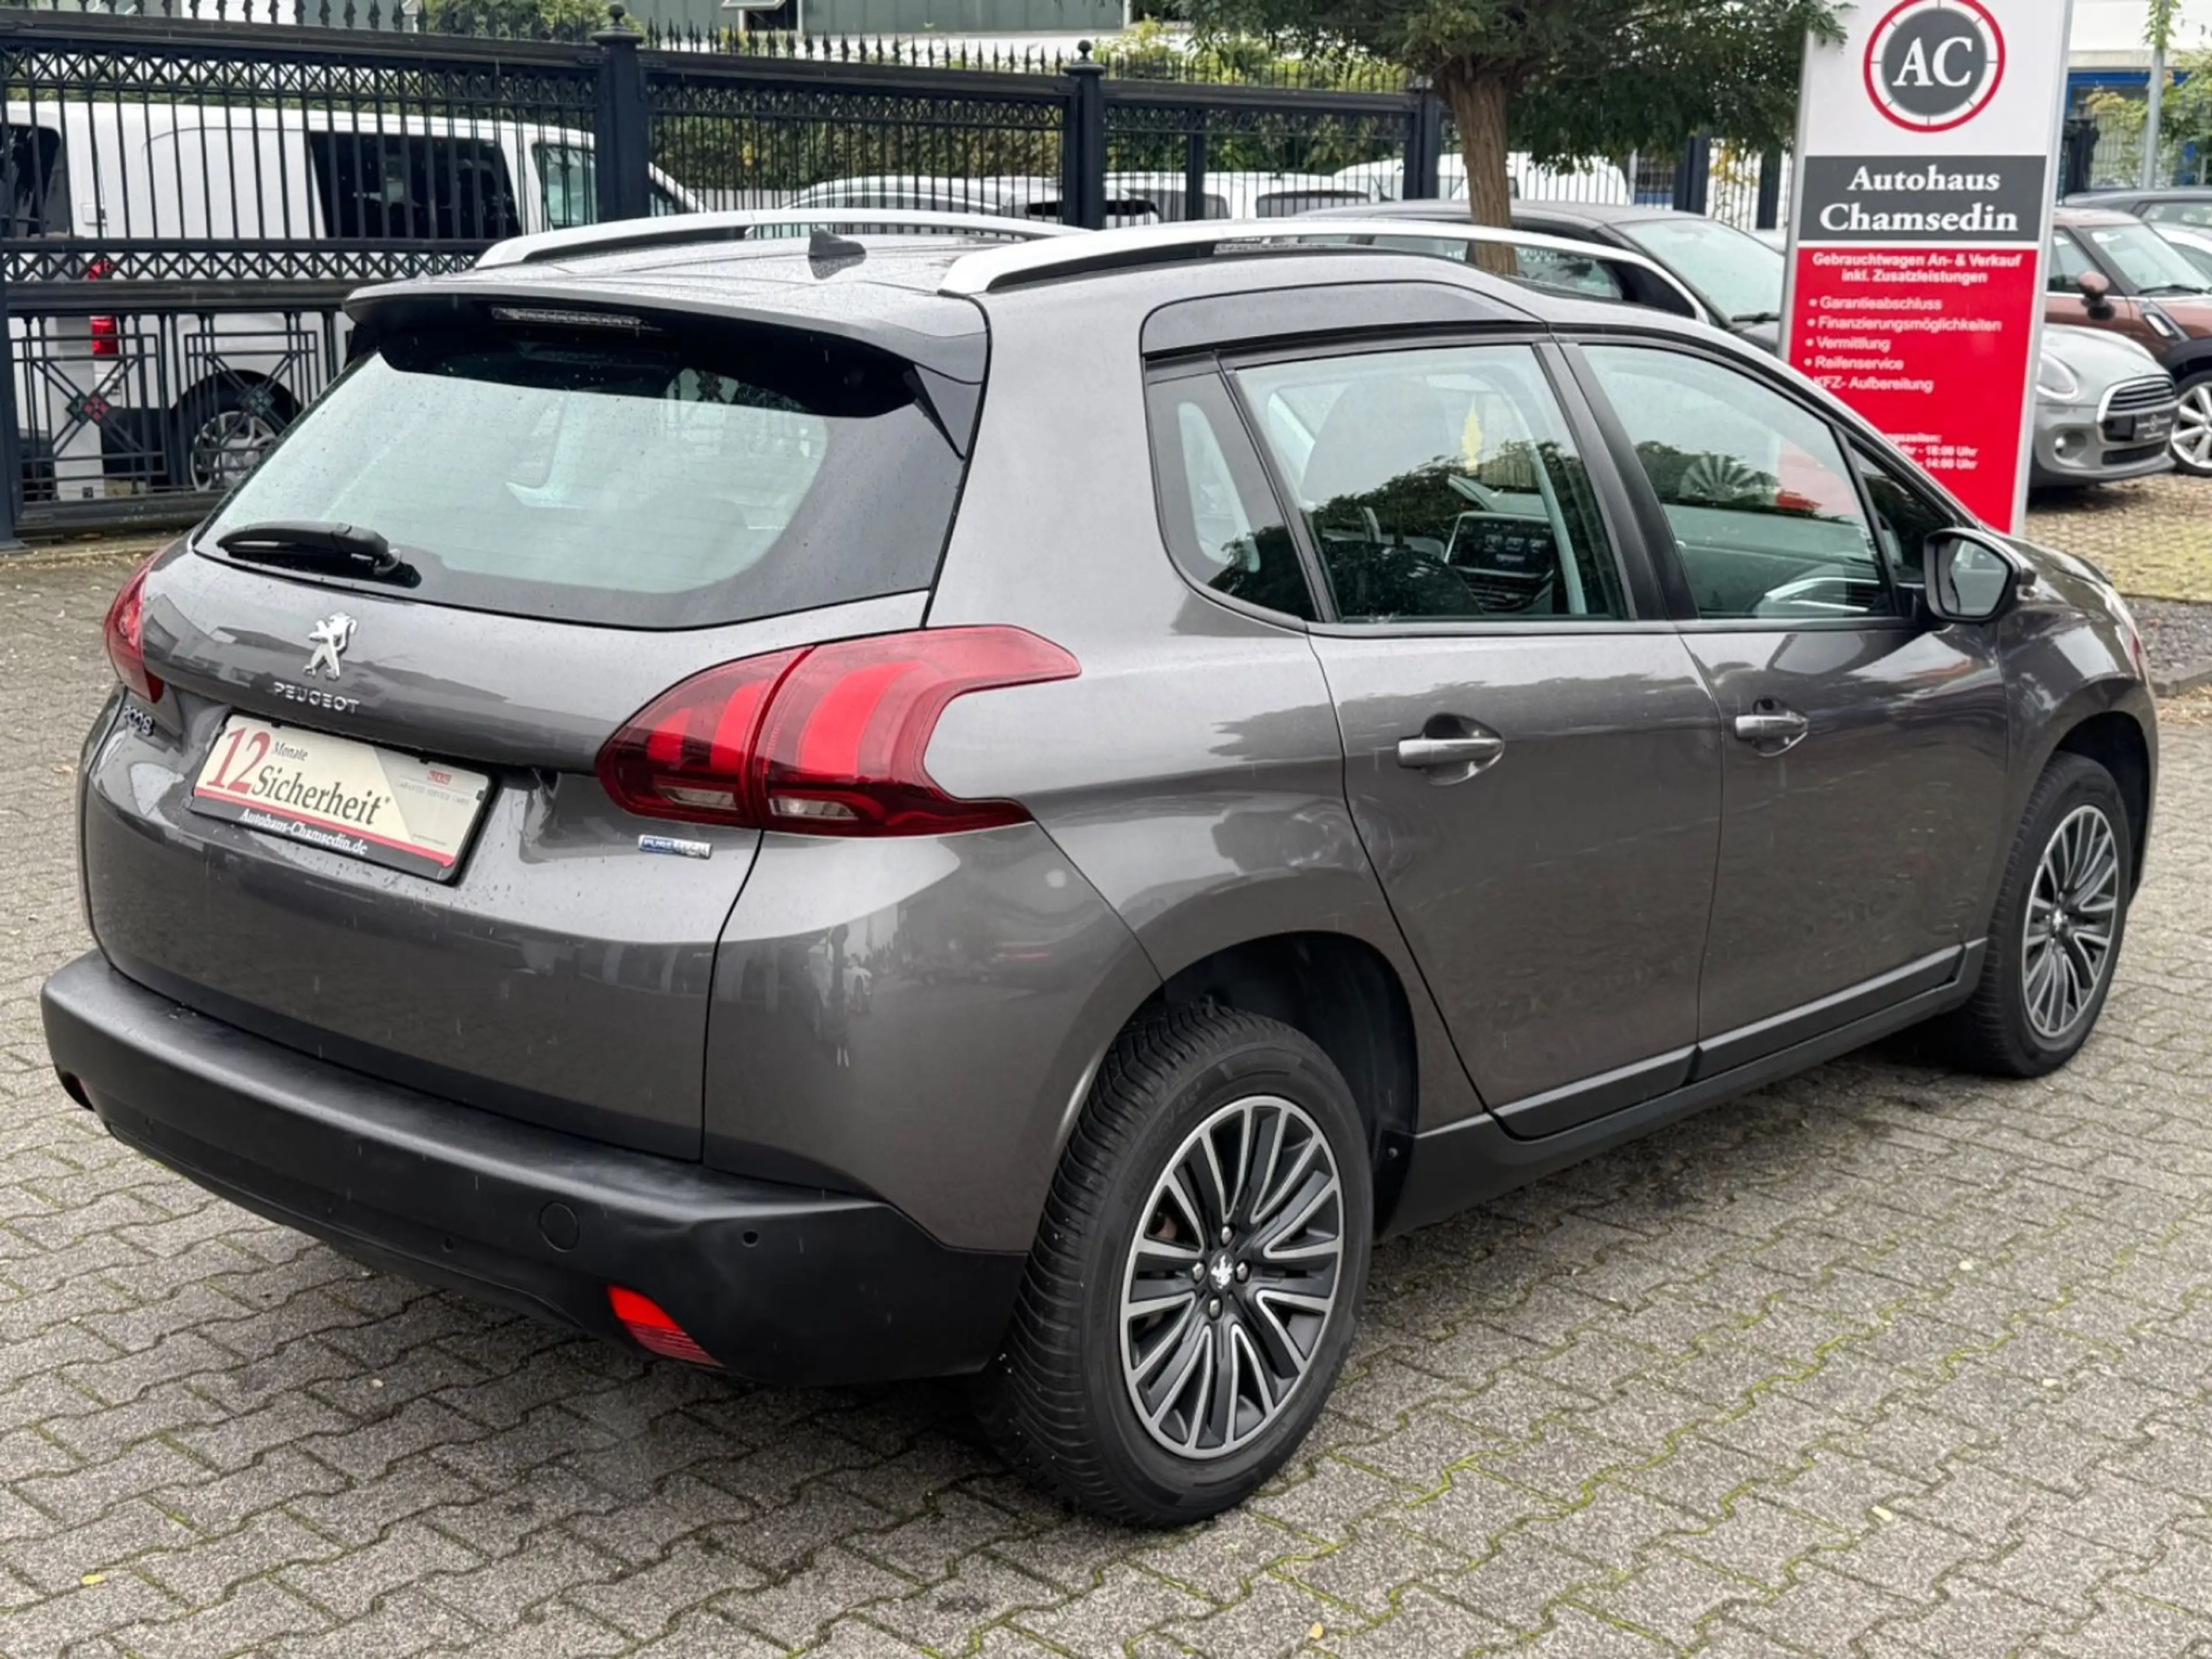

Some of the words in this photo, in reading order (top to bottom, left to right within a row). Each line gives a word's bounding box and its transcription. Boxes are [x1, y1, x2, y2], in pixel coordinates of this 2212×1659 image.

[1892, 37, 1973, 87] AC
[1847, 165, 2001, 191] Autohaus
[1820, 202, 2018, 232] Chamsedin
[1812, 252, 1925, 269] Gebrauchtwagen
[1927, 253, 1953, 266] An-
[1955, 253, 1966, 266] &
[1969, 253, 2022, 267] Verkauf
[1842, 269, 1870, 282] inkl.
[1872, 269, 1988, 286] Zusatzleistungen
[1820, 296, 1942, 310] Garantieabschluss
[1817, 315, 2002, 334] Finanzierungsmöglichkeiten
[1816, 336, 1891, 353] Vermittlung
[1815, 355, 1904, 370] Reifenservice
[1849, 376, 1934, 393] Aufbereitung
[274, 681, 360, 714] PEUGEOT
[206, 726, 271, 794] 12
[275, 741, 308, 762] Monate
